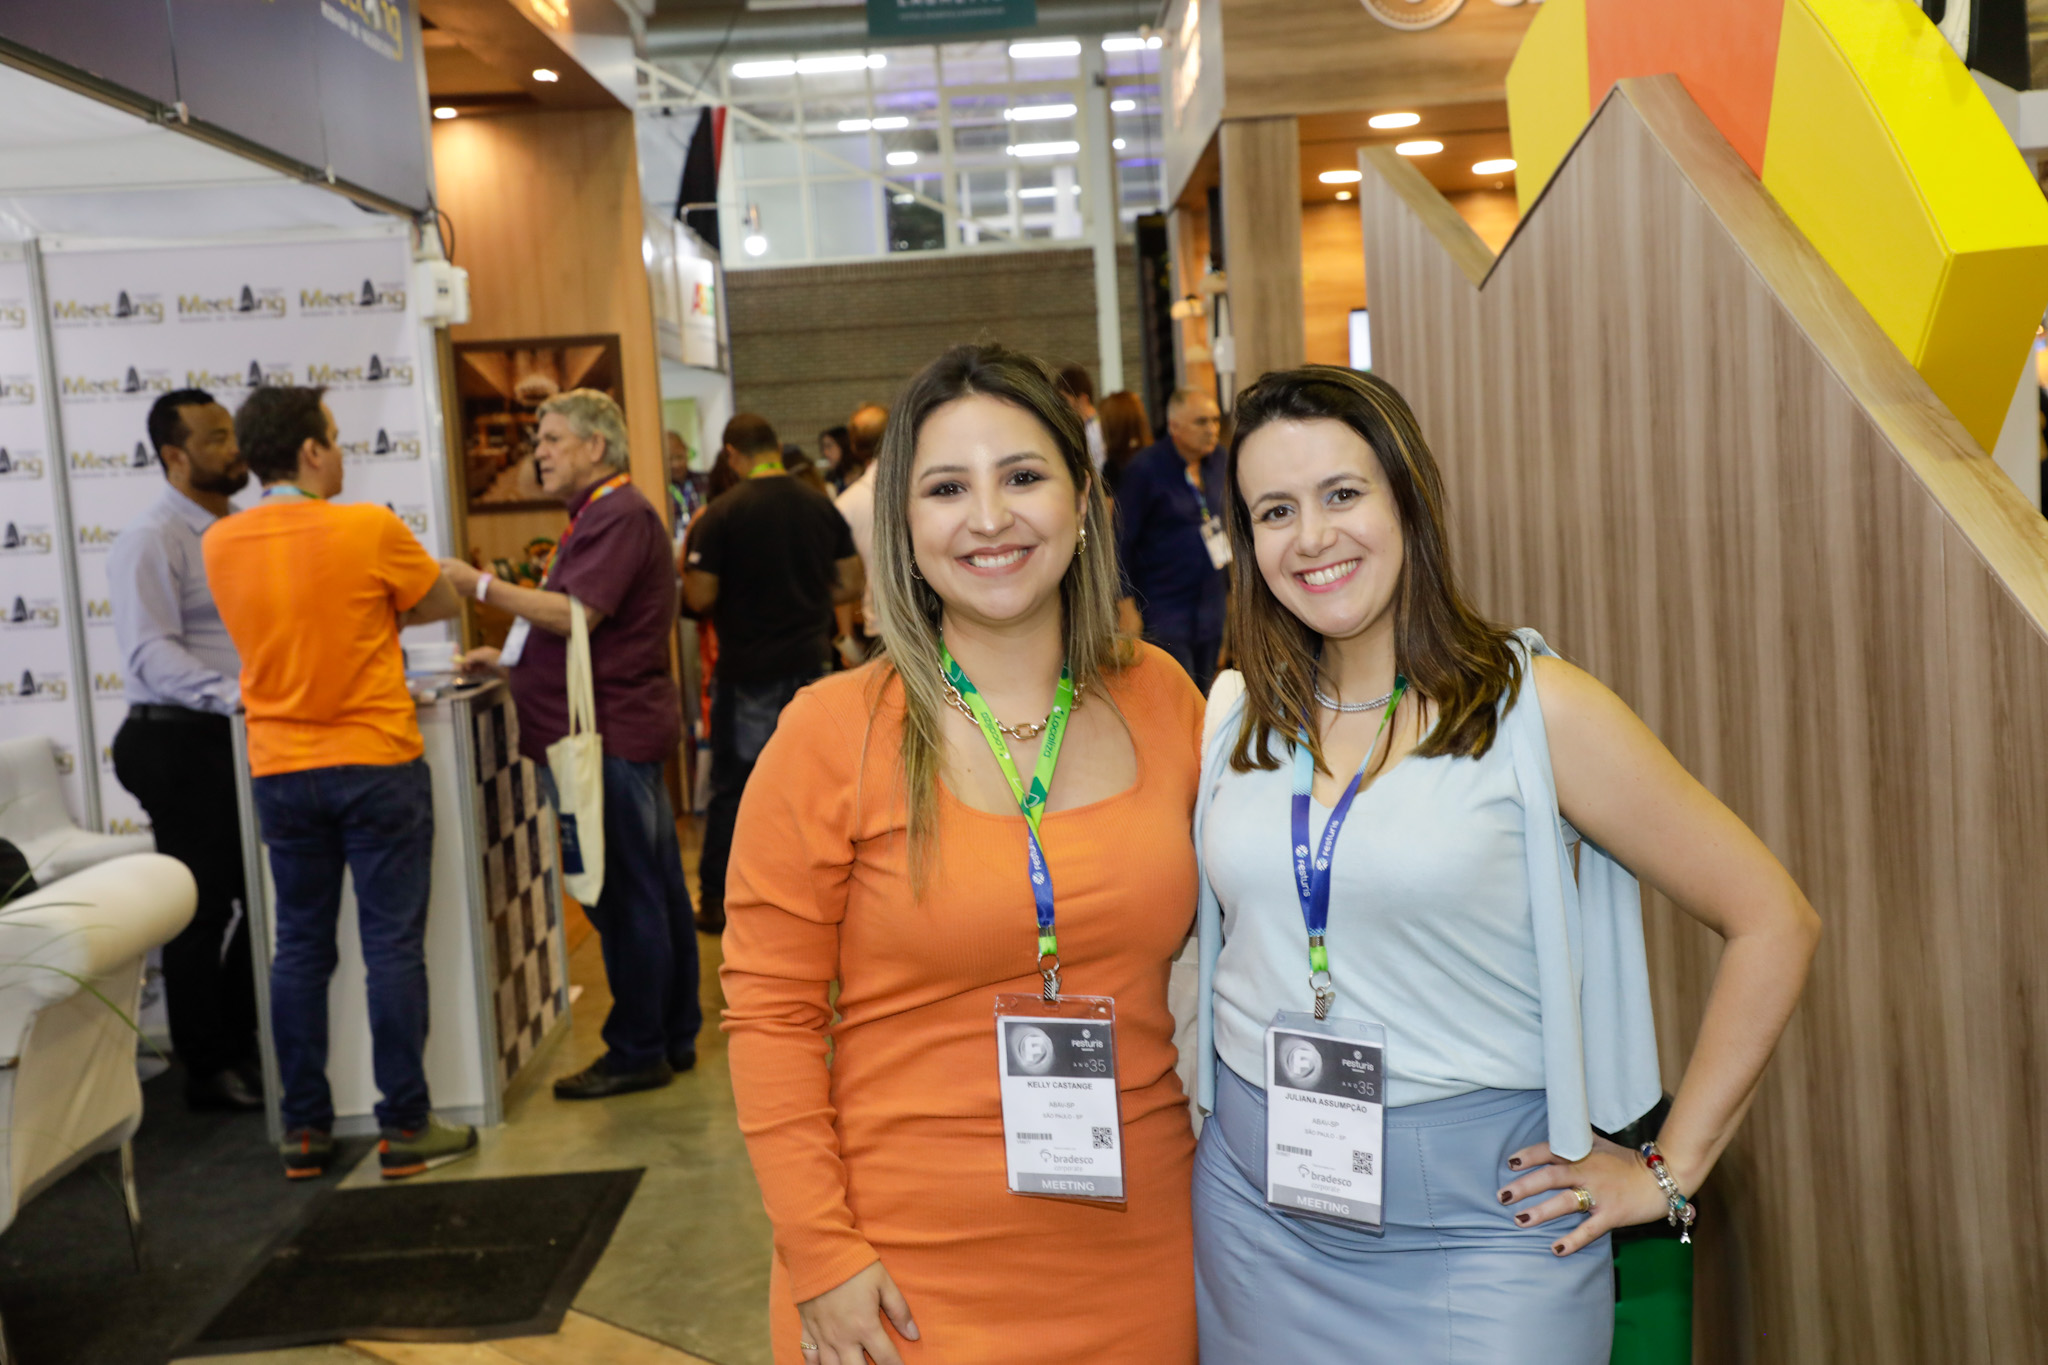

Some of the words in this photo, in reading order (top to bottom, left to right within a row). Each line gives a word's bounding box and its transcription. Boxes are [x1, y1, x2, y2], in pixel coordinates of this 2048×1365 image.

[981, 712, 1006, 752] Localiza
[1043, 714, 1062, 758] Localiza
[1322, 819, 1340, 857] Festuris
[1297, 859, 1312, 897] Festuris
[1071, 1039, 1104, 1048] Festuris
[1089, 1059, 1107, 1073] 35
[1342, 1058, 1375, 1072] Festuris
[1027, 1081, 1051, 1089] KELLY
[1052, 1081, 1093, 1090] CASTANGE
[1358, 1081, 1375, 1097] 35
[1285, 1092, 1317, 1104] JULIANA
[1318, 1098, 1368, 1113] ASSUMPÇÃO
[1053, 1154, 1094, 1165] bradesco
[1041, 1180, 1095, 1191] MEETING
[1311, 1171, 1352, 1187] bradesco
[1297, 1194, 1351, 1215] MEETING
